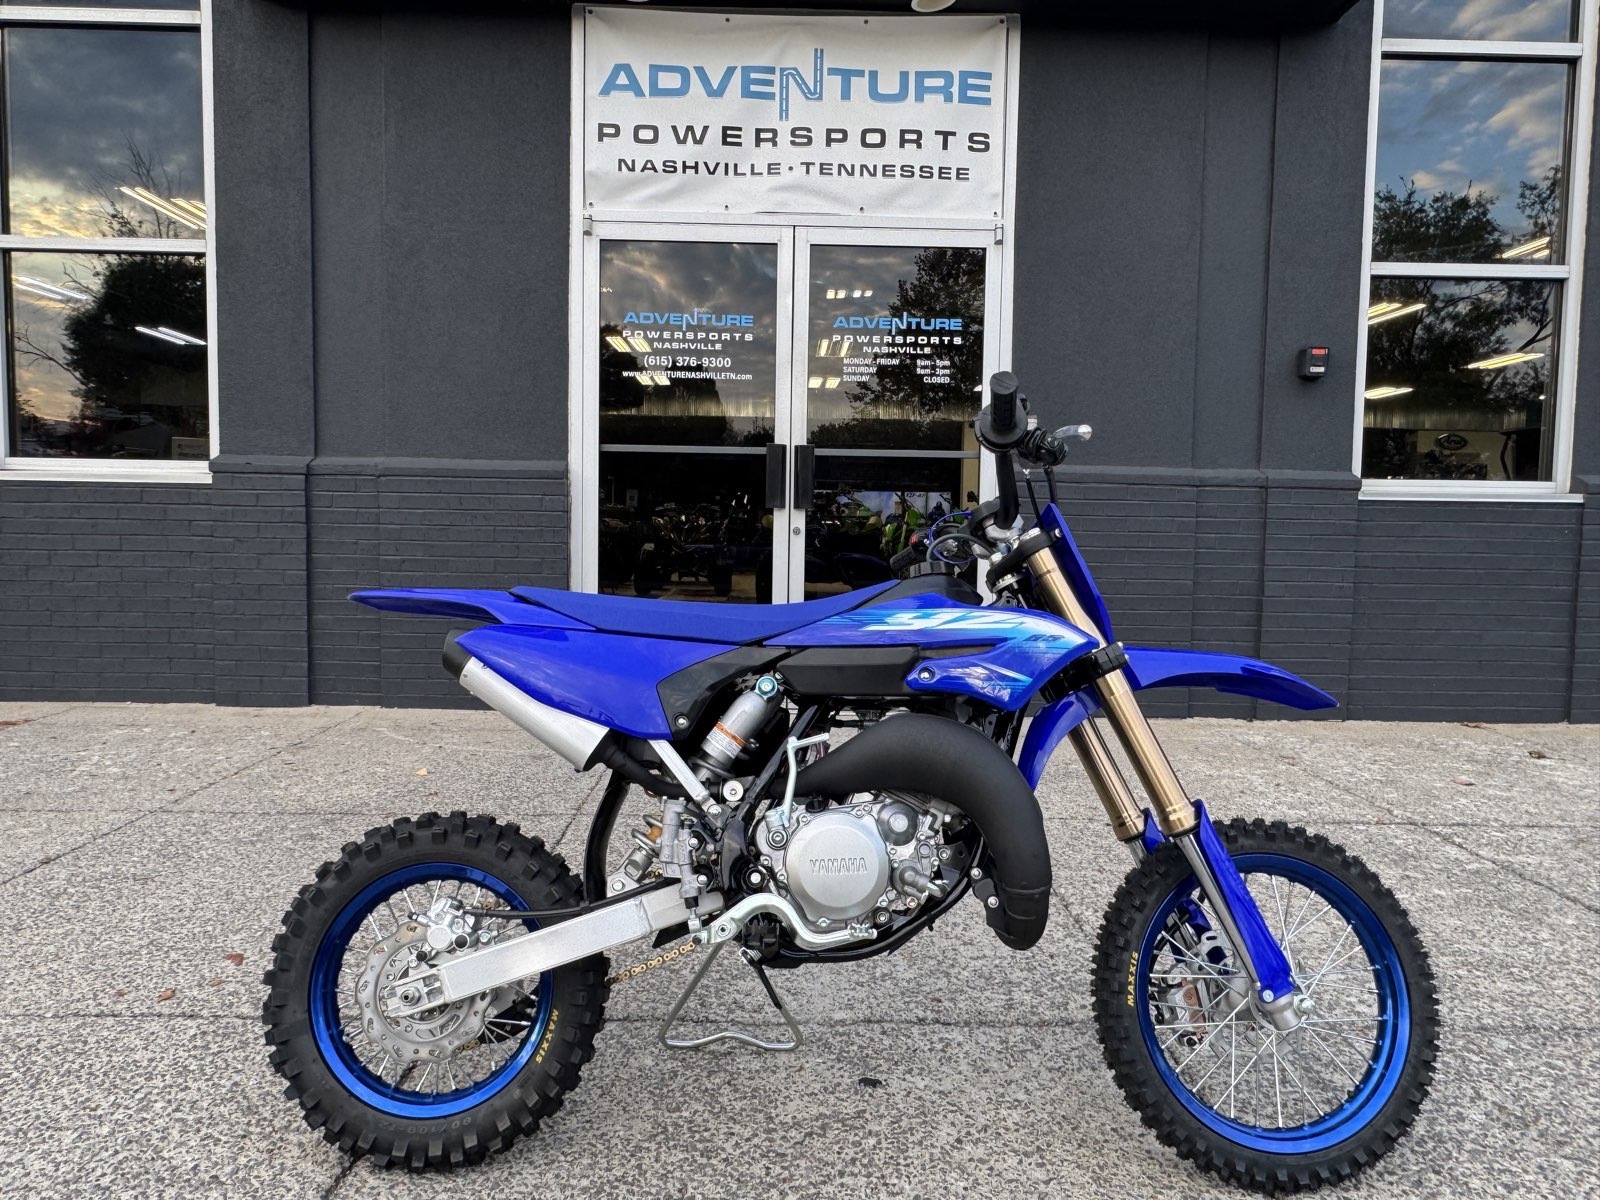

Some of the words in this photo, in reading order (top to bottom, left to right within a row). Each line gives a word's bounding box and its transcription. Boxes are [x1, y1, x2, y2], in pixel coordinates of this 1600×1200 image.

[598, 48, 992, 121] ADVENTURE
[598, 123, 991, 153] POWERSPORTS
[617, 159, 782, 176] NASHVILLE
[800, 161, 970, 181] TENNESSEE
[623, 308, 754, 331] ADVENTURE
[833, 312, 963, 335] ADVENTURE
[622, 331, 754, 341] POWERSPORTS
[653, 341, 723, 350] NASHVILLE
[832, 335, 962, 344] POWERSPORTS
[863, 346, 931, 354] NASHVILLE
[643, 355, 673, 368] (615)
[676, 356, 732, 368] 376-9300
[842, 366, 878, 374] SATURDAY
[809, 857, 868, 875] YAMAHA
[1127, 951, 1138, 1007] MAXXIS
[535, 1008, 559, 1064] MAXXIS
